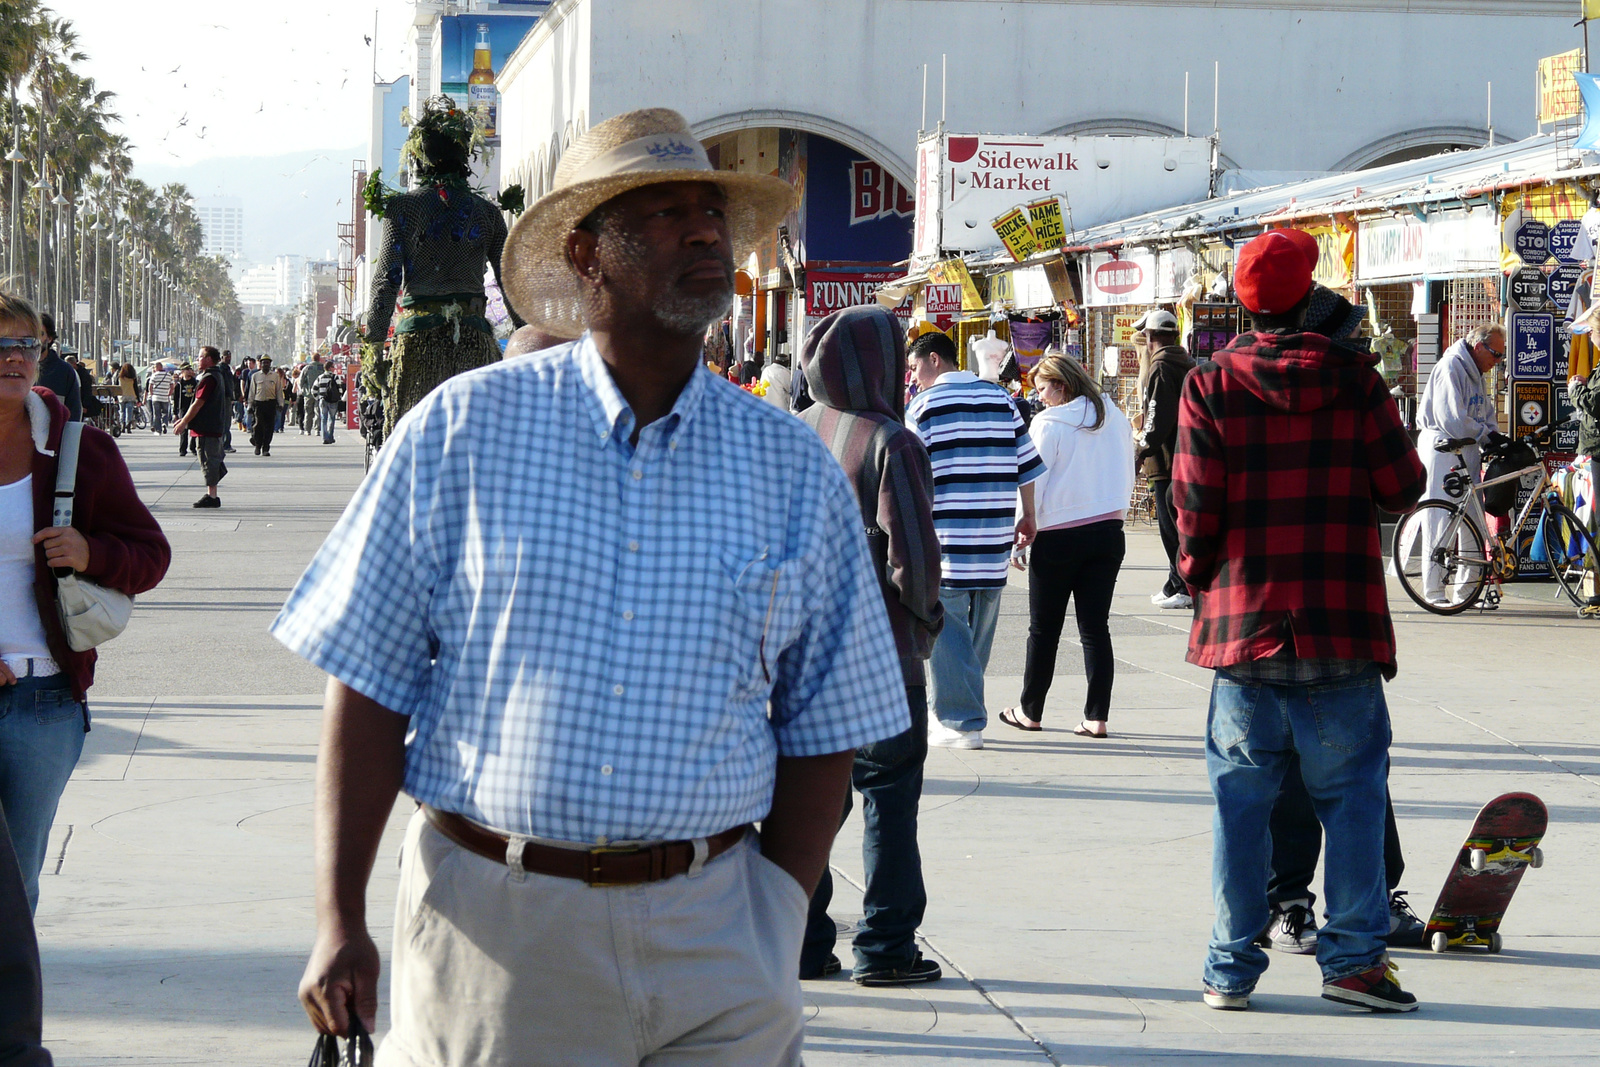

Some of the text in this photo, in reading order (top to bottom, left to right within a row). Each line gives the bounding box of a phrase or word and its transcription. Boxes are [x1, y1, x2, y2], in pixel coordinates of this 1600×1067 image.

[977, 150, 1079, 171] Sidewalk
[970, 171, 1052, 191] Market
[1029, 202, 1060, 222] NAME
[995, 213, 1028, 240] SOCKS
[1042, 217, 1052, 225] ON
[1035, 222, 1063, 240] RICE
[1009, 234, 1021, 246] 5
[1403, 225, 1423, 261] LAND
[927, 285, 961, 303] ATM
[927, 303, 960, 311] MACHINE
[1517, 318, 1550, 327] RESERVED
[1519, 326, 1546, 334] PARKING
[1517, 349, 1548, 364] Dodgers
[1518, 365, 1547, 373] FANS ONLY
[1516, 386, 1548, 394] RESERVED
[1558, 437, 1576, 445] FANS
